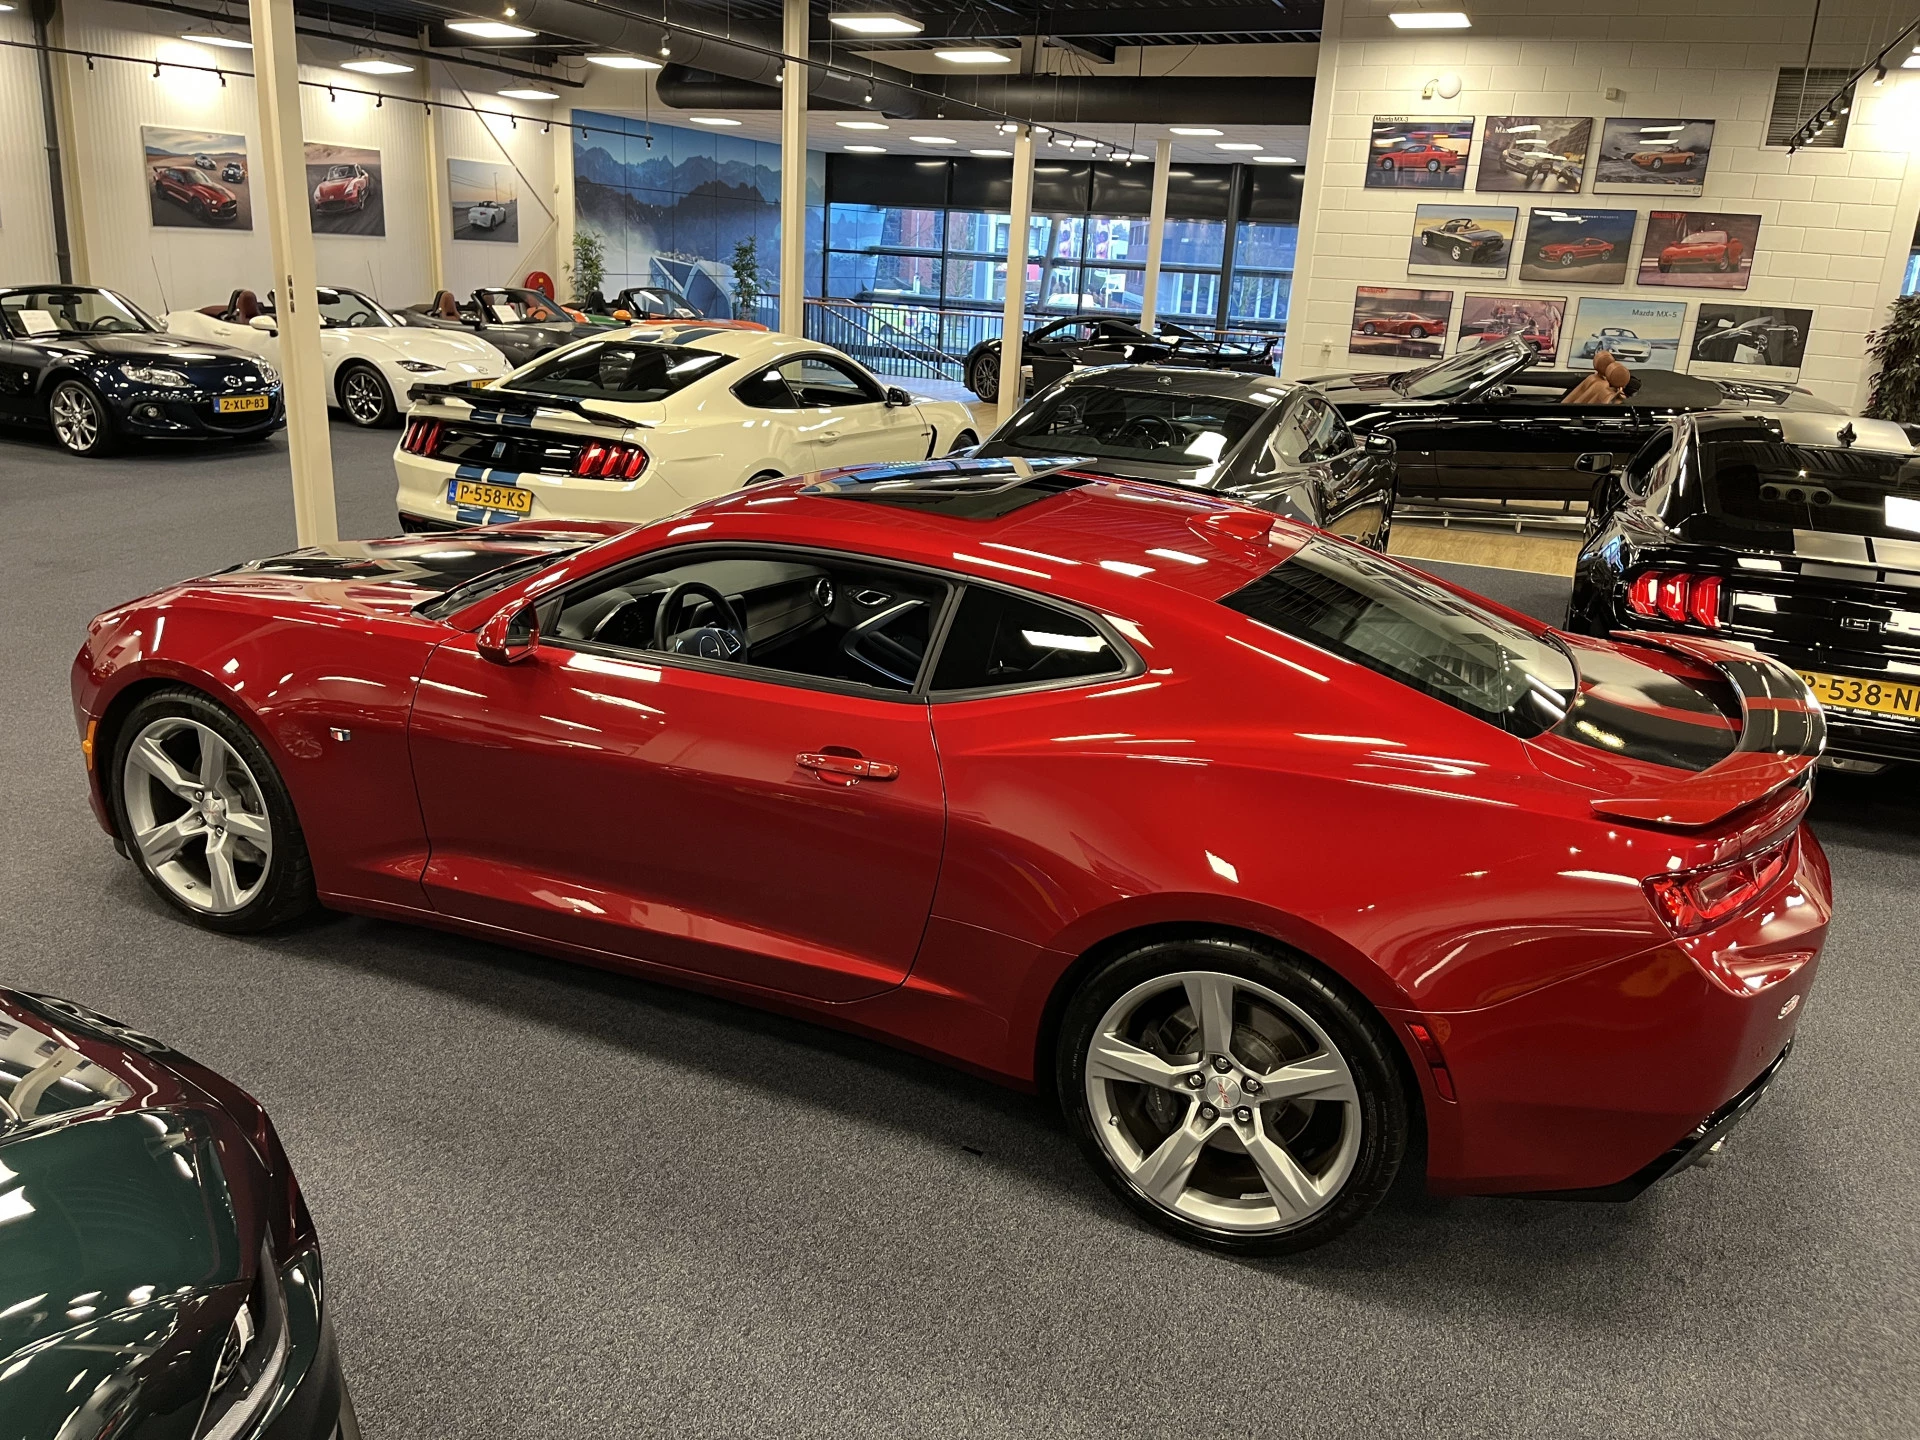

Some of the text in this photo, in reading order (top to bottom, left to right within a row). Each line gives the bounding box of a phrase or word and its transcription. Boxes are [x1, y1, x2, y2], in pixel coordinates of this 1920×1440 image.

[1632, 309, 1677, 318] Mazda MX-5
[223, 398, 265, 411] 2-XLP-83
[460, 484, 526, 508] P-558-KS
